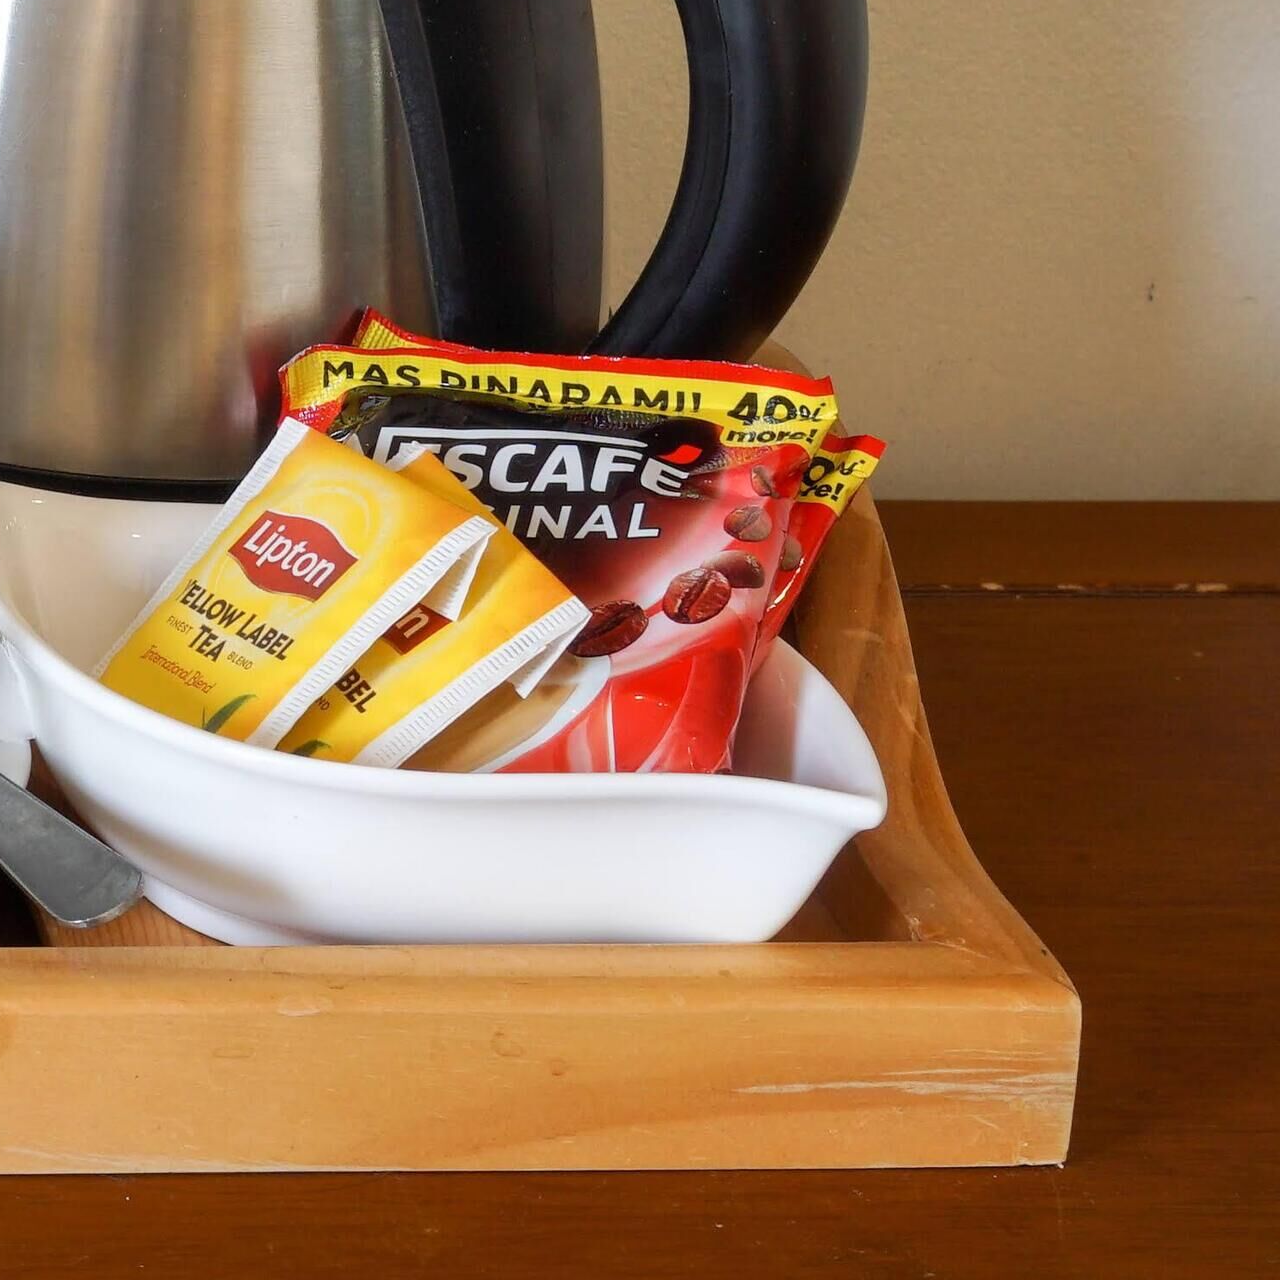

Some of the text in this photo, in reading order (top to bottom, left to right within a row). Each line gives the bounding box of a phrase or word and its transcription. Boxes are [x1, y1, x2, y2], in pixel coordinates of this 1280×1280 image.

[323, 360, 421, 388] MAS
[243, 520, 336, 588] Lipton
[166, 615, 194, 634] FINEST
[237, 614, 295, 661] LABEL
[188, 624, 228, 663] TEA
[227, 651, 253, 670] BLEND
